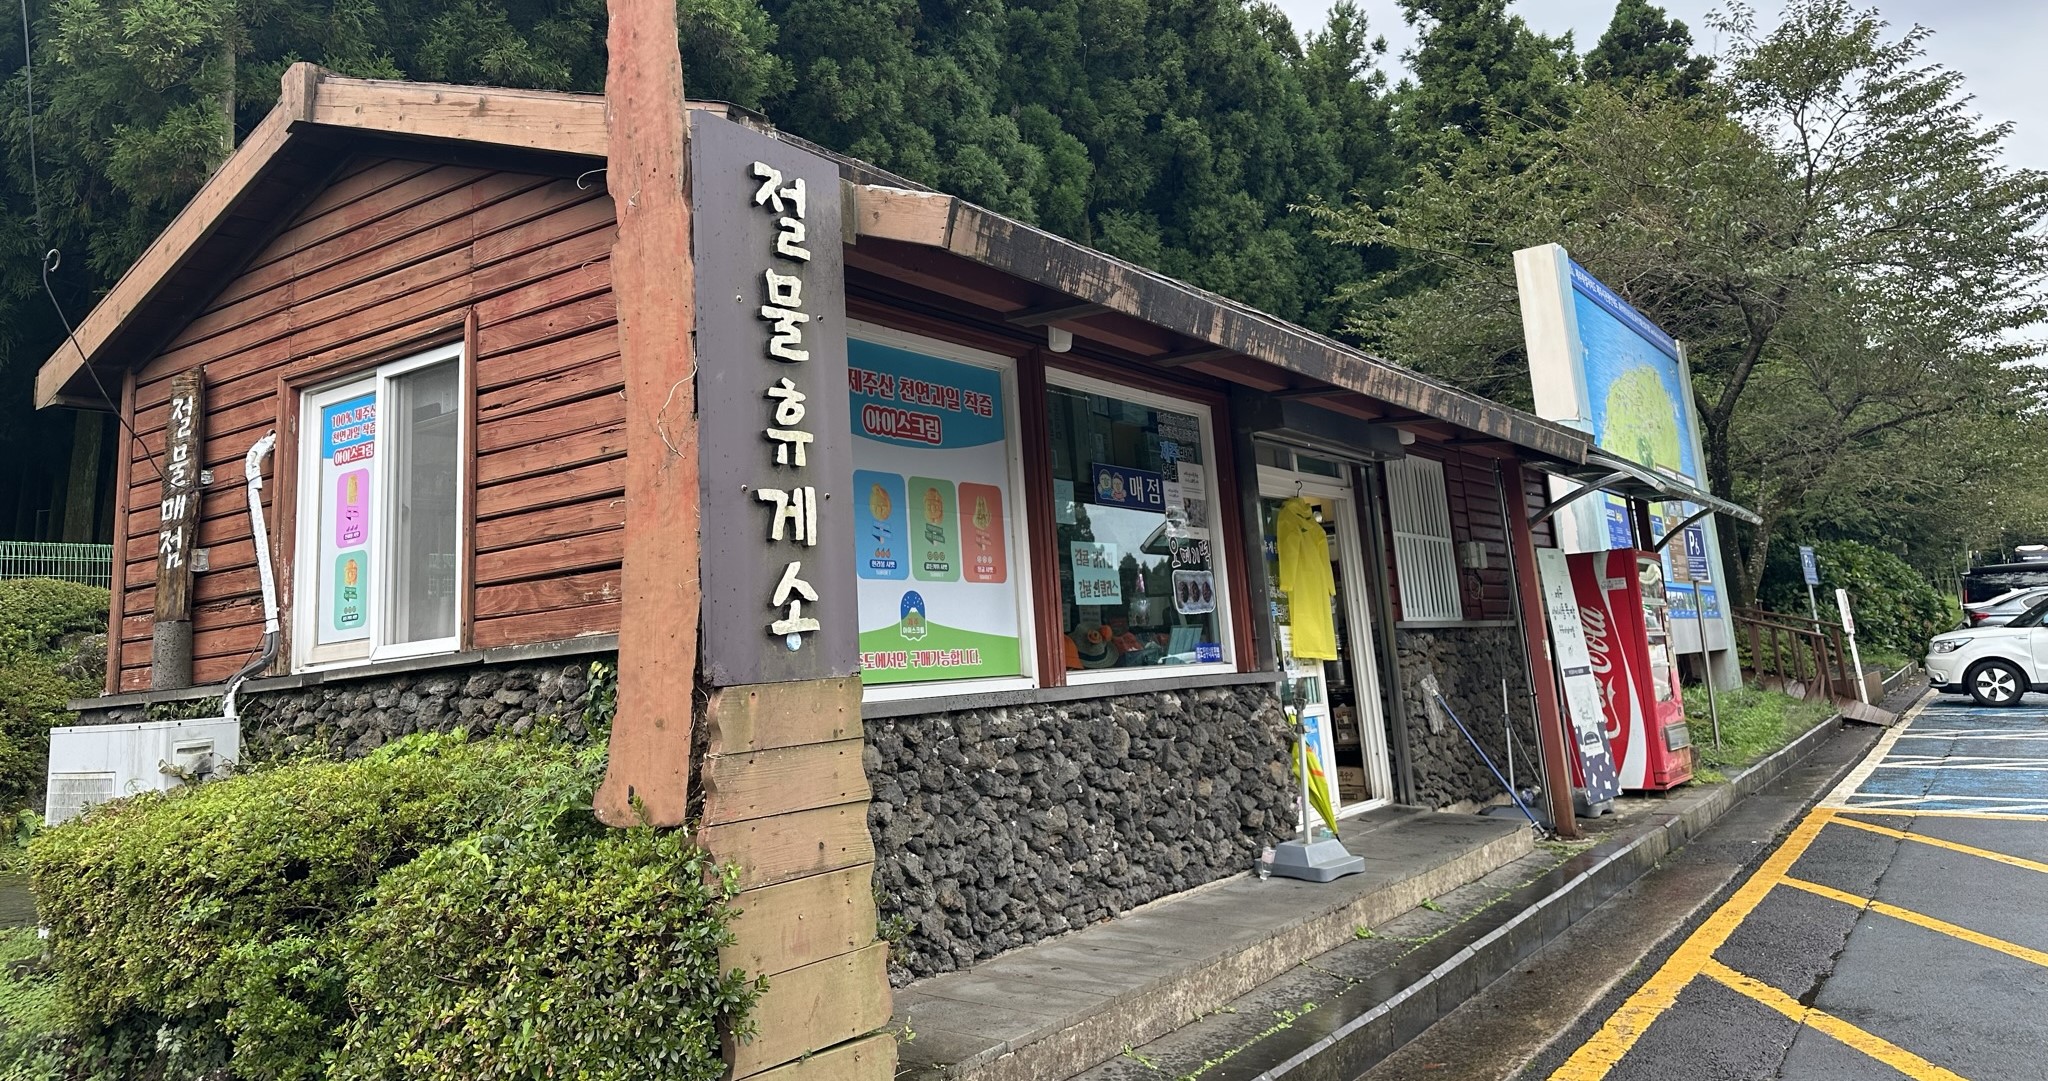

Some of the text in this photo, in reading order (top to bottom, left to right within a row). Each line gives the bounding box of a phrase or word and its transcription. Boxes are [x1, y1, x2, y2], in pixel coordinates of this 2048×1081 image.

[752, 161, 820, 636] 절물휴게소
[900, 377, 961, 410] 천연과일
[964, 391, 993, 416] 착즙
[332, 411, 352, 428] 100%
[865, 407, 940, 442] 아이스크림
[333, 425, 360, 444] 천연과일
[334, 442, 374, 465] 아이스크림
[160, 395, 193, 570] 절물매점
[1128, 475, 1161, 504] 매점
[911, 648, 982, 668] 구매가능합니다.
